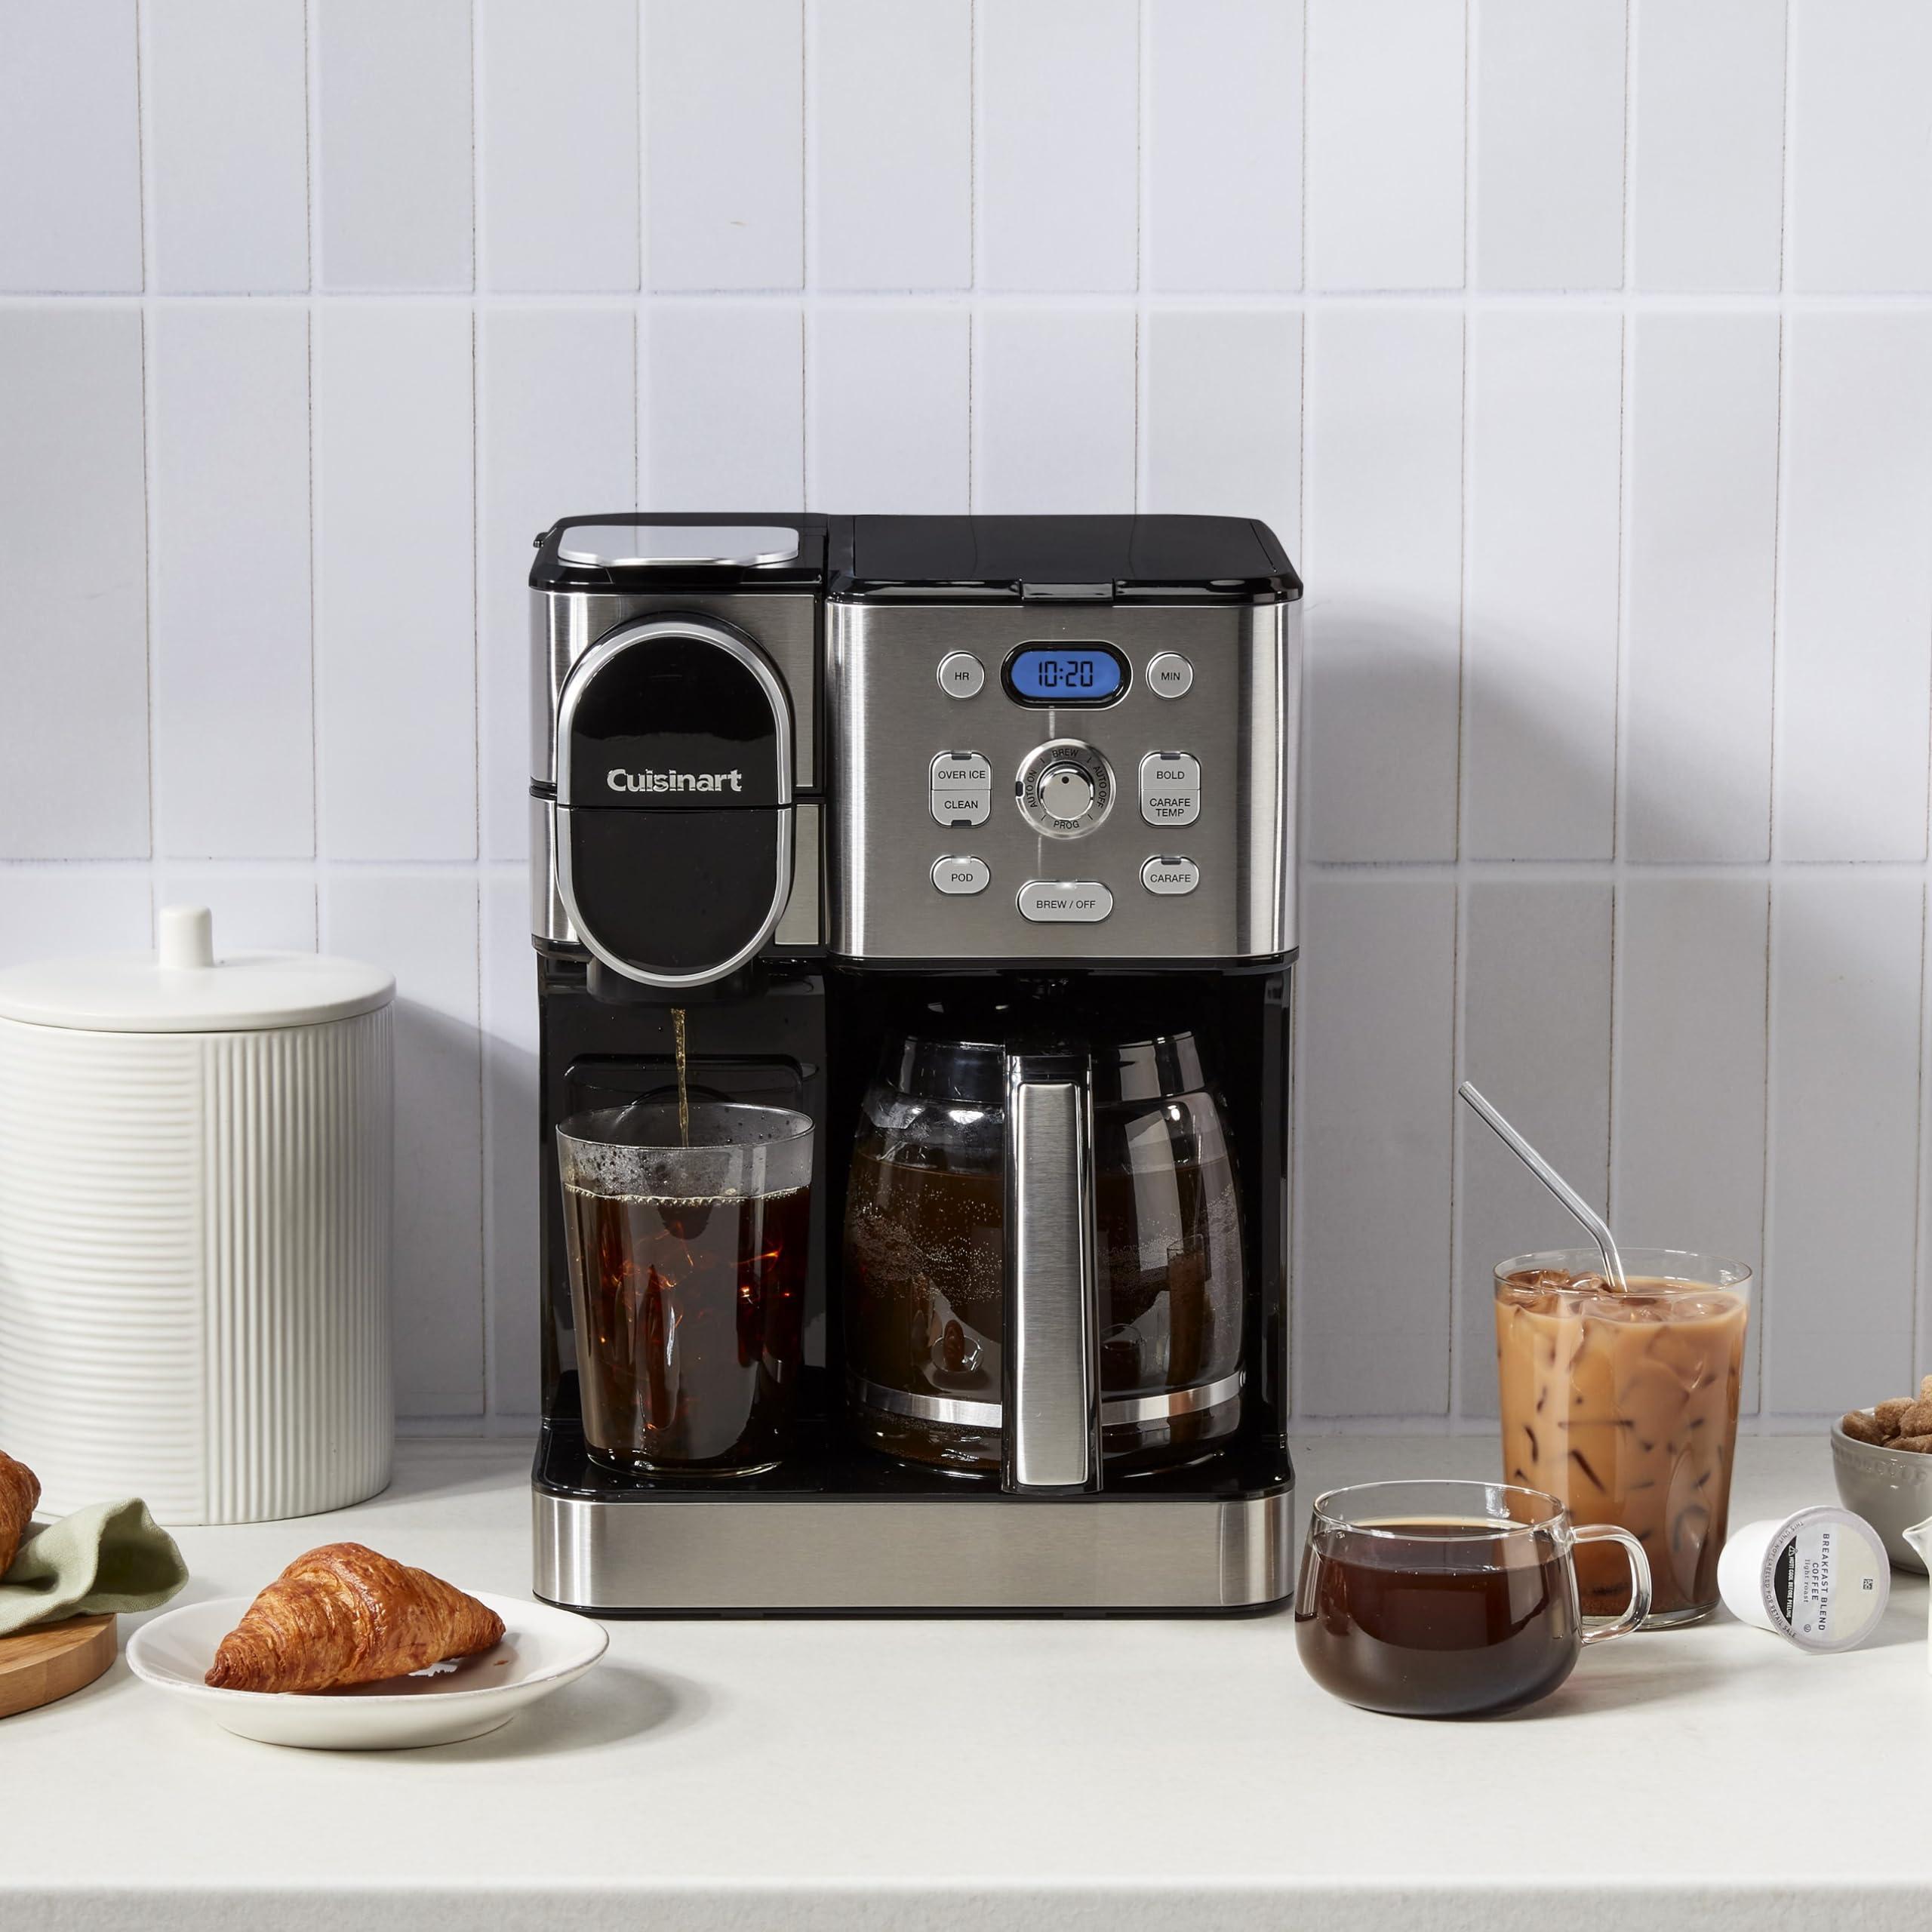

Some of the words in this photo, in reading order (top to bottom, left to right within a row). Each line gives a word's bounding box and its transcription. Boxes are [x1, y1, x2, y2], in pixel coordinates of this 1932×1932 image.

[955, 672, 970, 681] HR
[1038, 660, 1094, 688] 10:20
[1161, 672, 1180, 681] MIN
[1052, 749, 1079, 758] BREW
[607, 768, 742, 792] Cuisinart
[938, 770, 967, 780] OVER
[969, 770, 986, 780] ICE
[1027, 770, 1037, 783] ON
[1094, 766, 1107, 789] AUTO
[1156, 771, 1185, 780] BOLD
[1026, 785, 1038, 808] AUTO
[1097, 792, 1107, 808] OFF
[944, 800, 978, 810] CLEAN
[1149, 798, 1191, 808] CARAFE
[1155, 808, 1184, 817] TEMP
[1054, 820, 1080, 829] PROG
[951, 873, 974, 882] POD
[1149, 874, 1191, 883] CARAFE
[1036, 900, 1066, 909] BREW
[1069, 899, 1073, 909] /
[1075, 900, 1096, 909] OFF
[1792, 1521, 1804, 1531] THIS
[1780, 1531, 1791, 1543] UNIT
[1770, 1545, 1780, 1557] NOT
[1821, 1534, 1829, 1593] BREAKFAST
[1765, 1558, 1774, 1588] LABELED
[1765, 1590, 1774, 1604] FOR
[1770, 1605, 1783, 1626] RETAIL
[1818, 1597, 1828, 1631] BLEND
[1782, 1625, 1796, 1638] SALE
